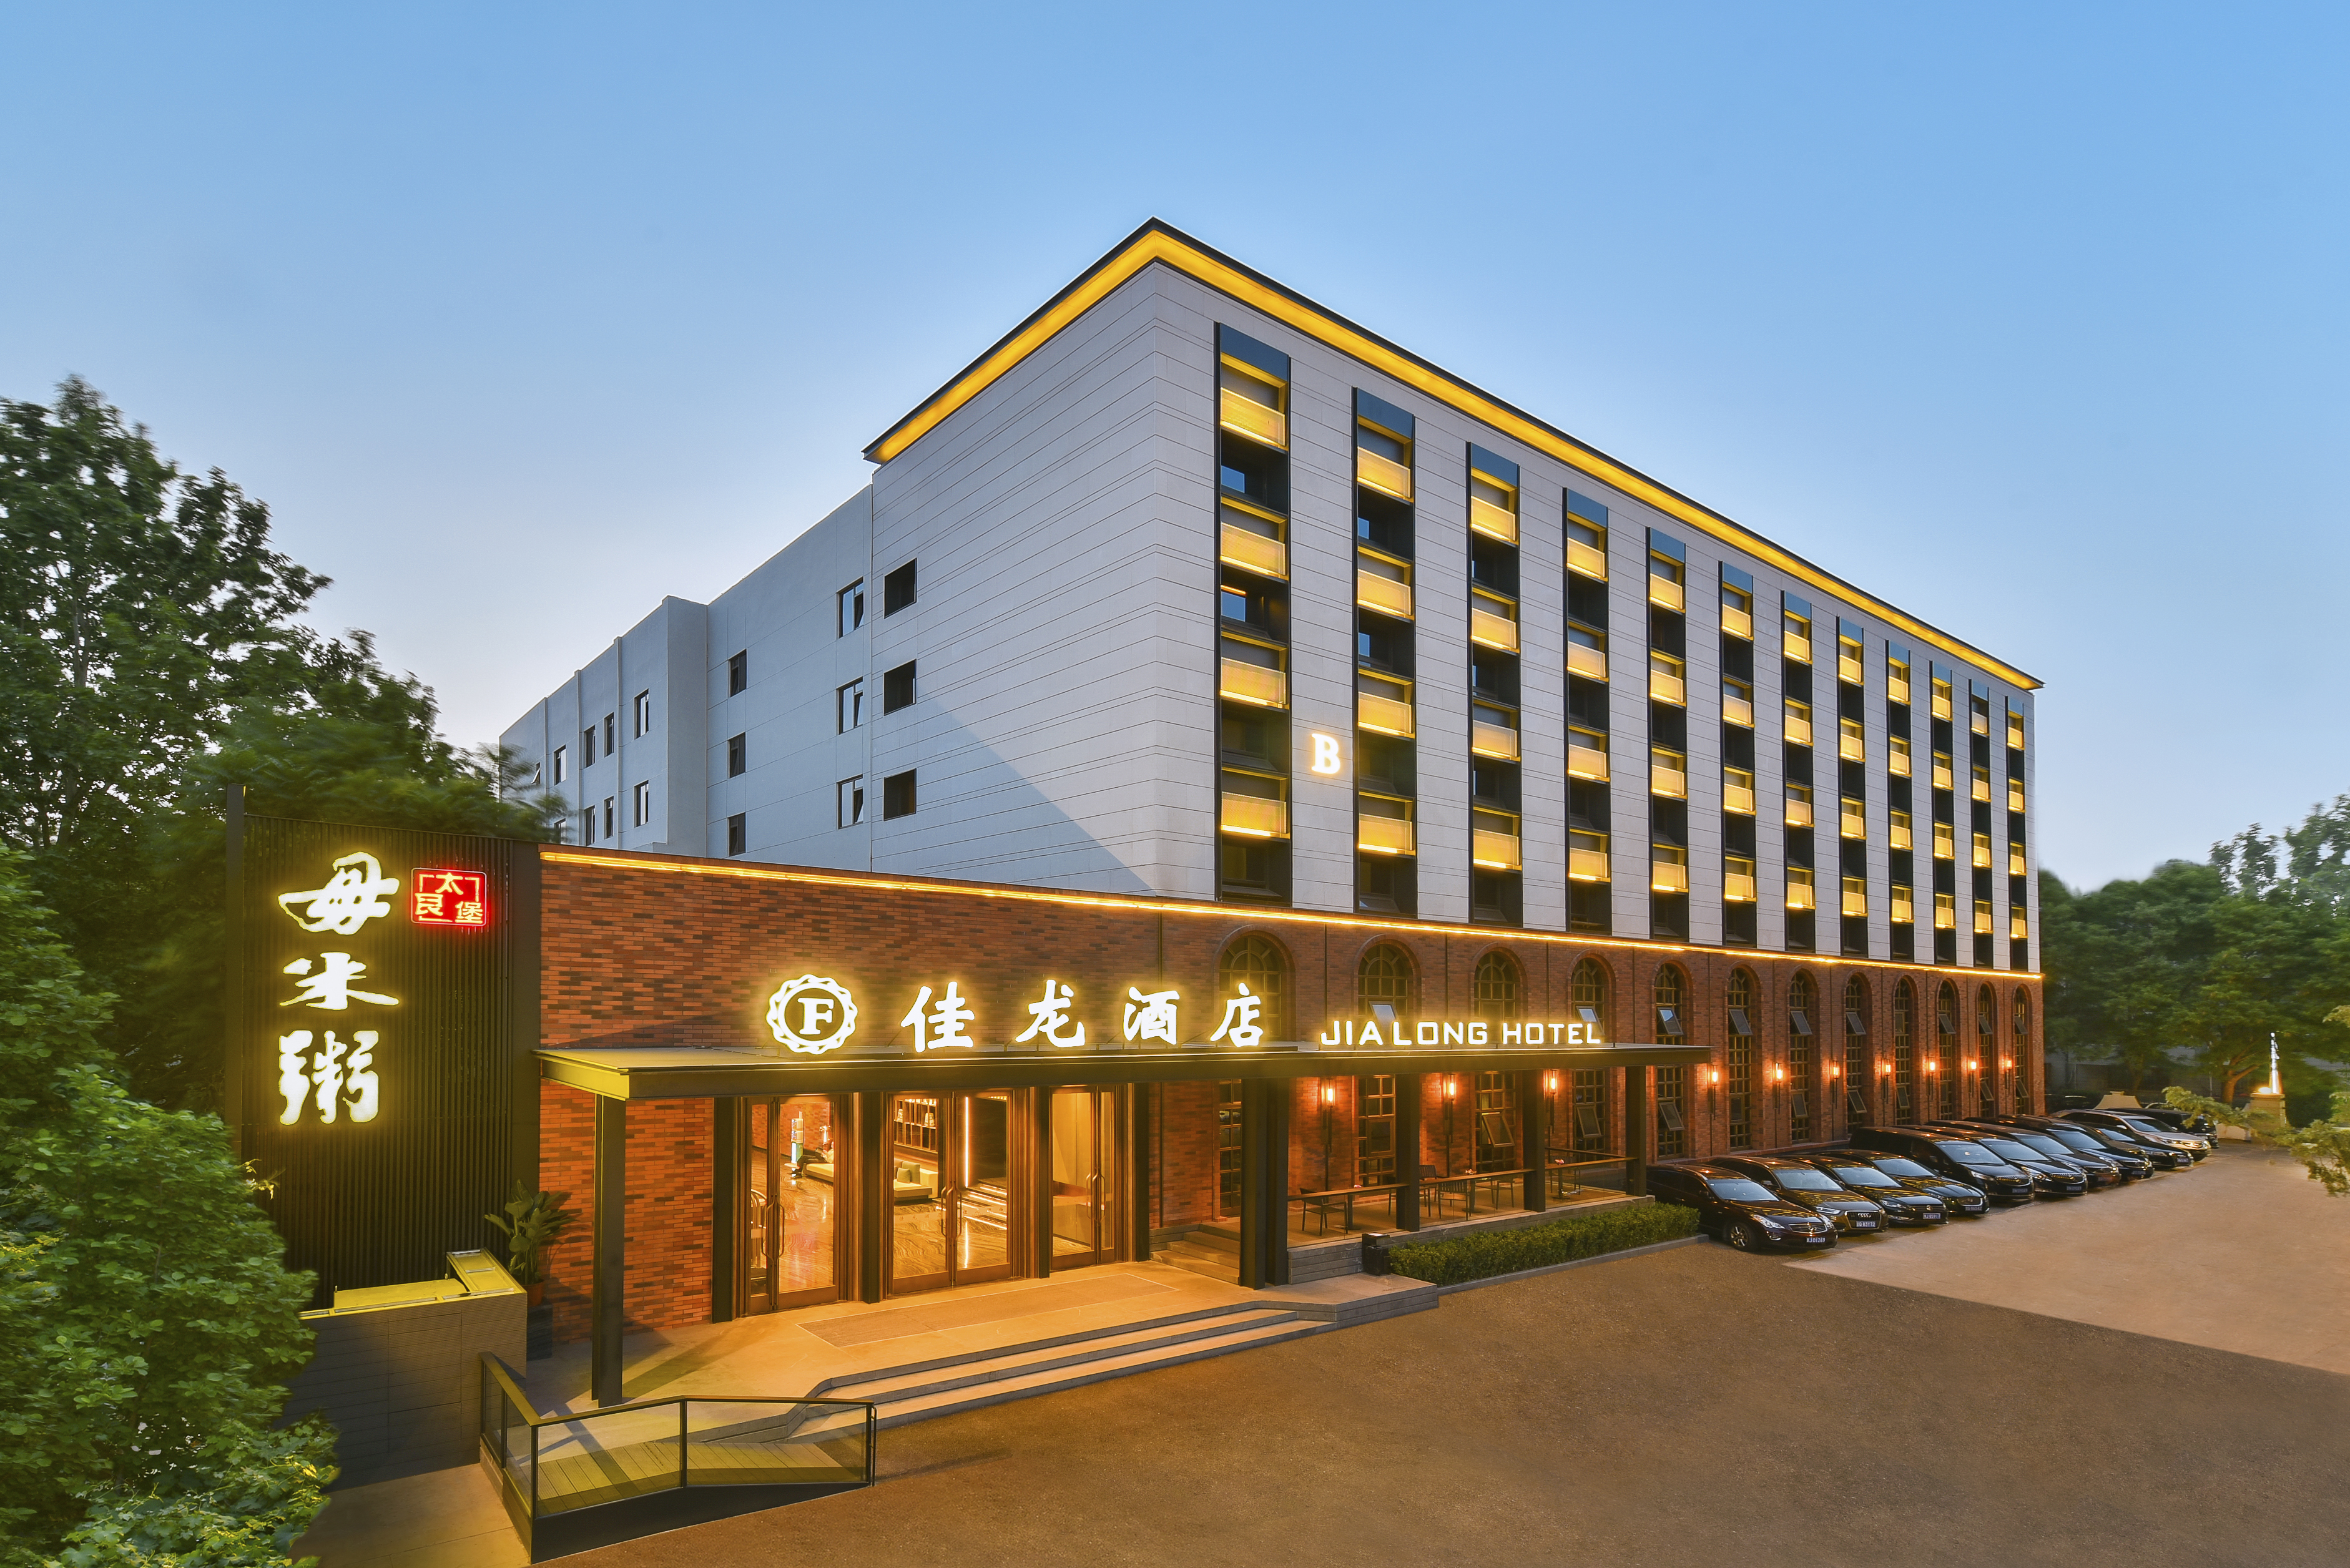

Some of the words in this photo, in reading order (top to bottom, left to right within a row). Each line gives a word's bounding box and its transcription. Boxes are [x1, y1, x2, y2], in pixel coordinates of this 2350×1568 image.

[1311, 733, 1341, 775] B
[797, 997, 834, 1035] F
[900, 979, 1264, 1053] 佳龙酒店
[1502, 1022, 1601, 1045] HOTEL
